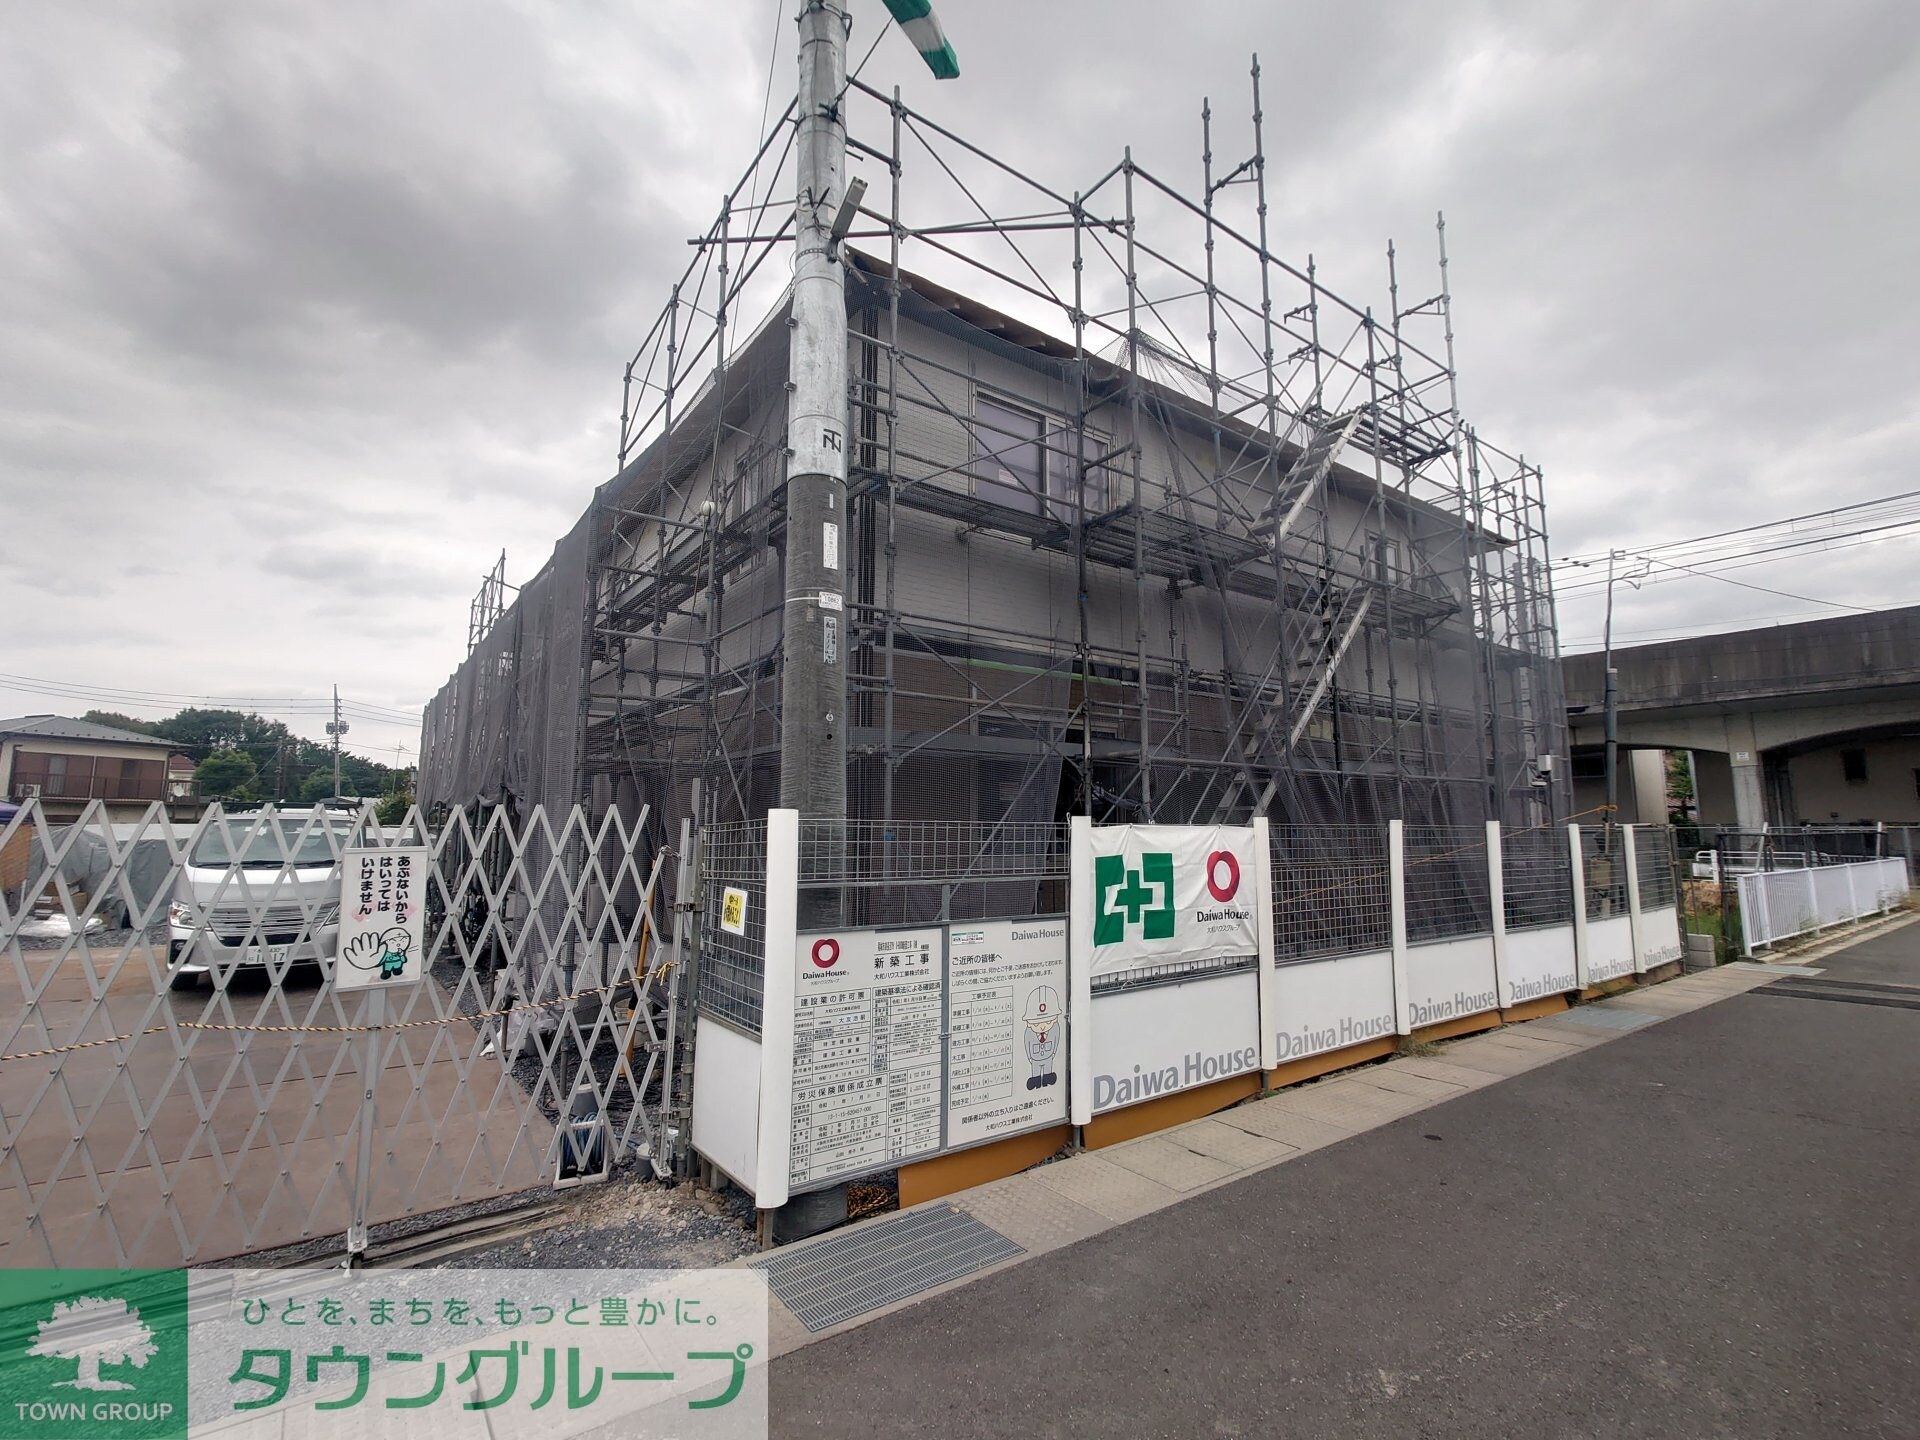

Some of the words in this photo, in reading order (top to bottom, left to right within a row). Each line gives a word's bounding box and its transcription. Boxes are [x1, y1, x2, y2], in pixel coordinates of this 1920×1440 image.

[358, 857, 375, 915] いけません
[377, 856, 393, 912] はいっては
[395, 856, 411, 924] あぶないから
[1197, 909, 1223, 922] Daiwa
[1224, 908, 1249, 920] House
[1012, 930, 1038, 940] Daiwa
[1039, 929, 1064, 938] House
[874, 953, 930, 970] 新築工事
[952, 953, 1003, 966] ご近所の皆様へ
[803, 971, 824, 980] Daiwa
[825, 969, 847, 978] House
[873, 968, 930, 980] 大和ハウス工業株式会社
[1543, 973, 1575, 993] House
[801, 991, 865, 1007] 建設業の許可票
[1409, 997, 1453, 1026] Daiwa
[1455, 991, 1495, 1014] House
[1276, 1024, 1336, 1060] Daiwa
[1340, 1014, 1392, 1043] House
[1093, 1064, 1179, 1110] Daiwa
[1184, 1047, 1256, 1085] House
[797, 1077, 882, 1101] 労災保険関係成立票
